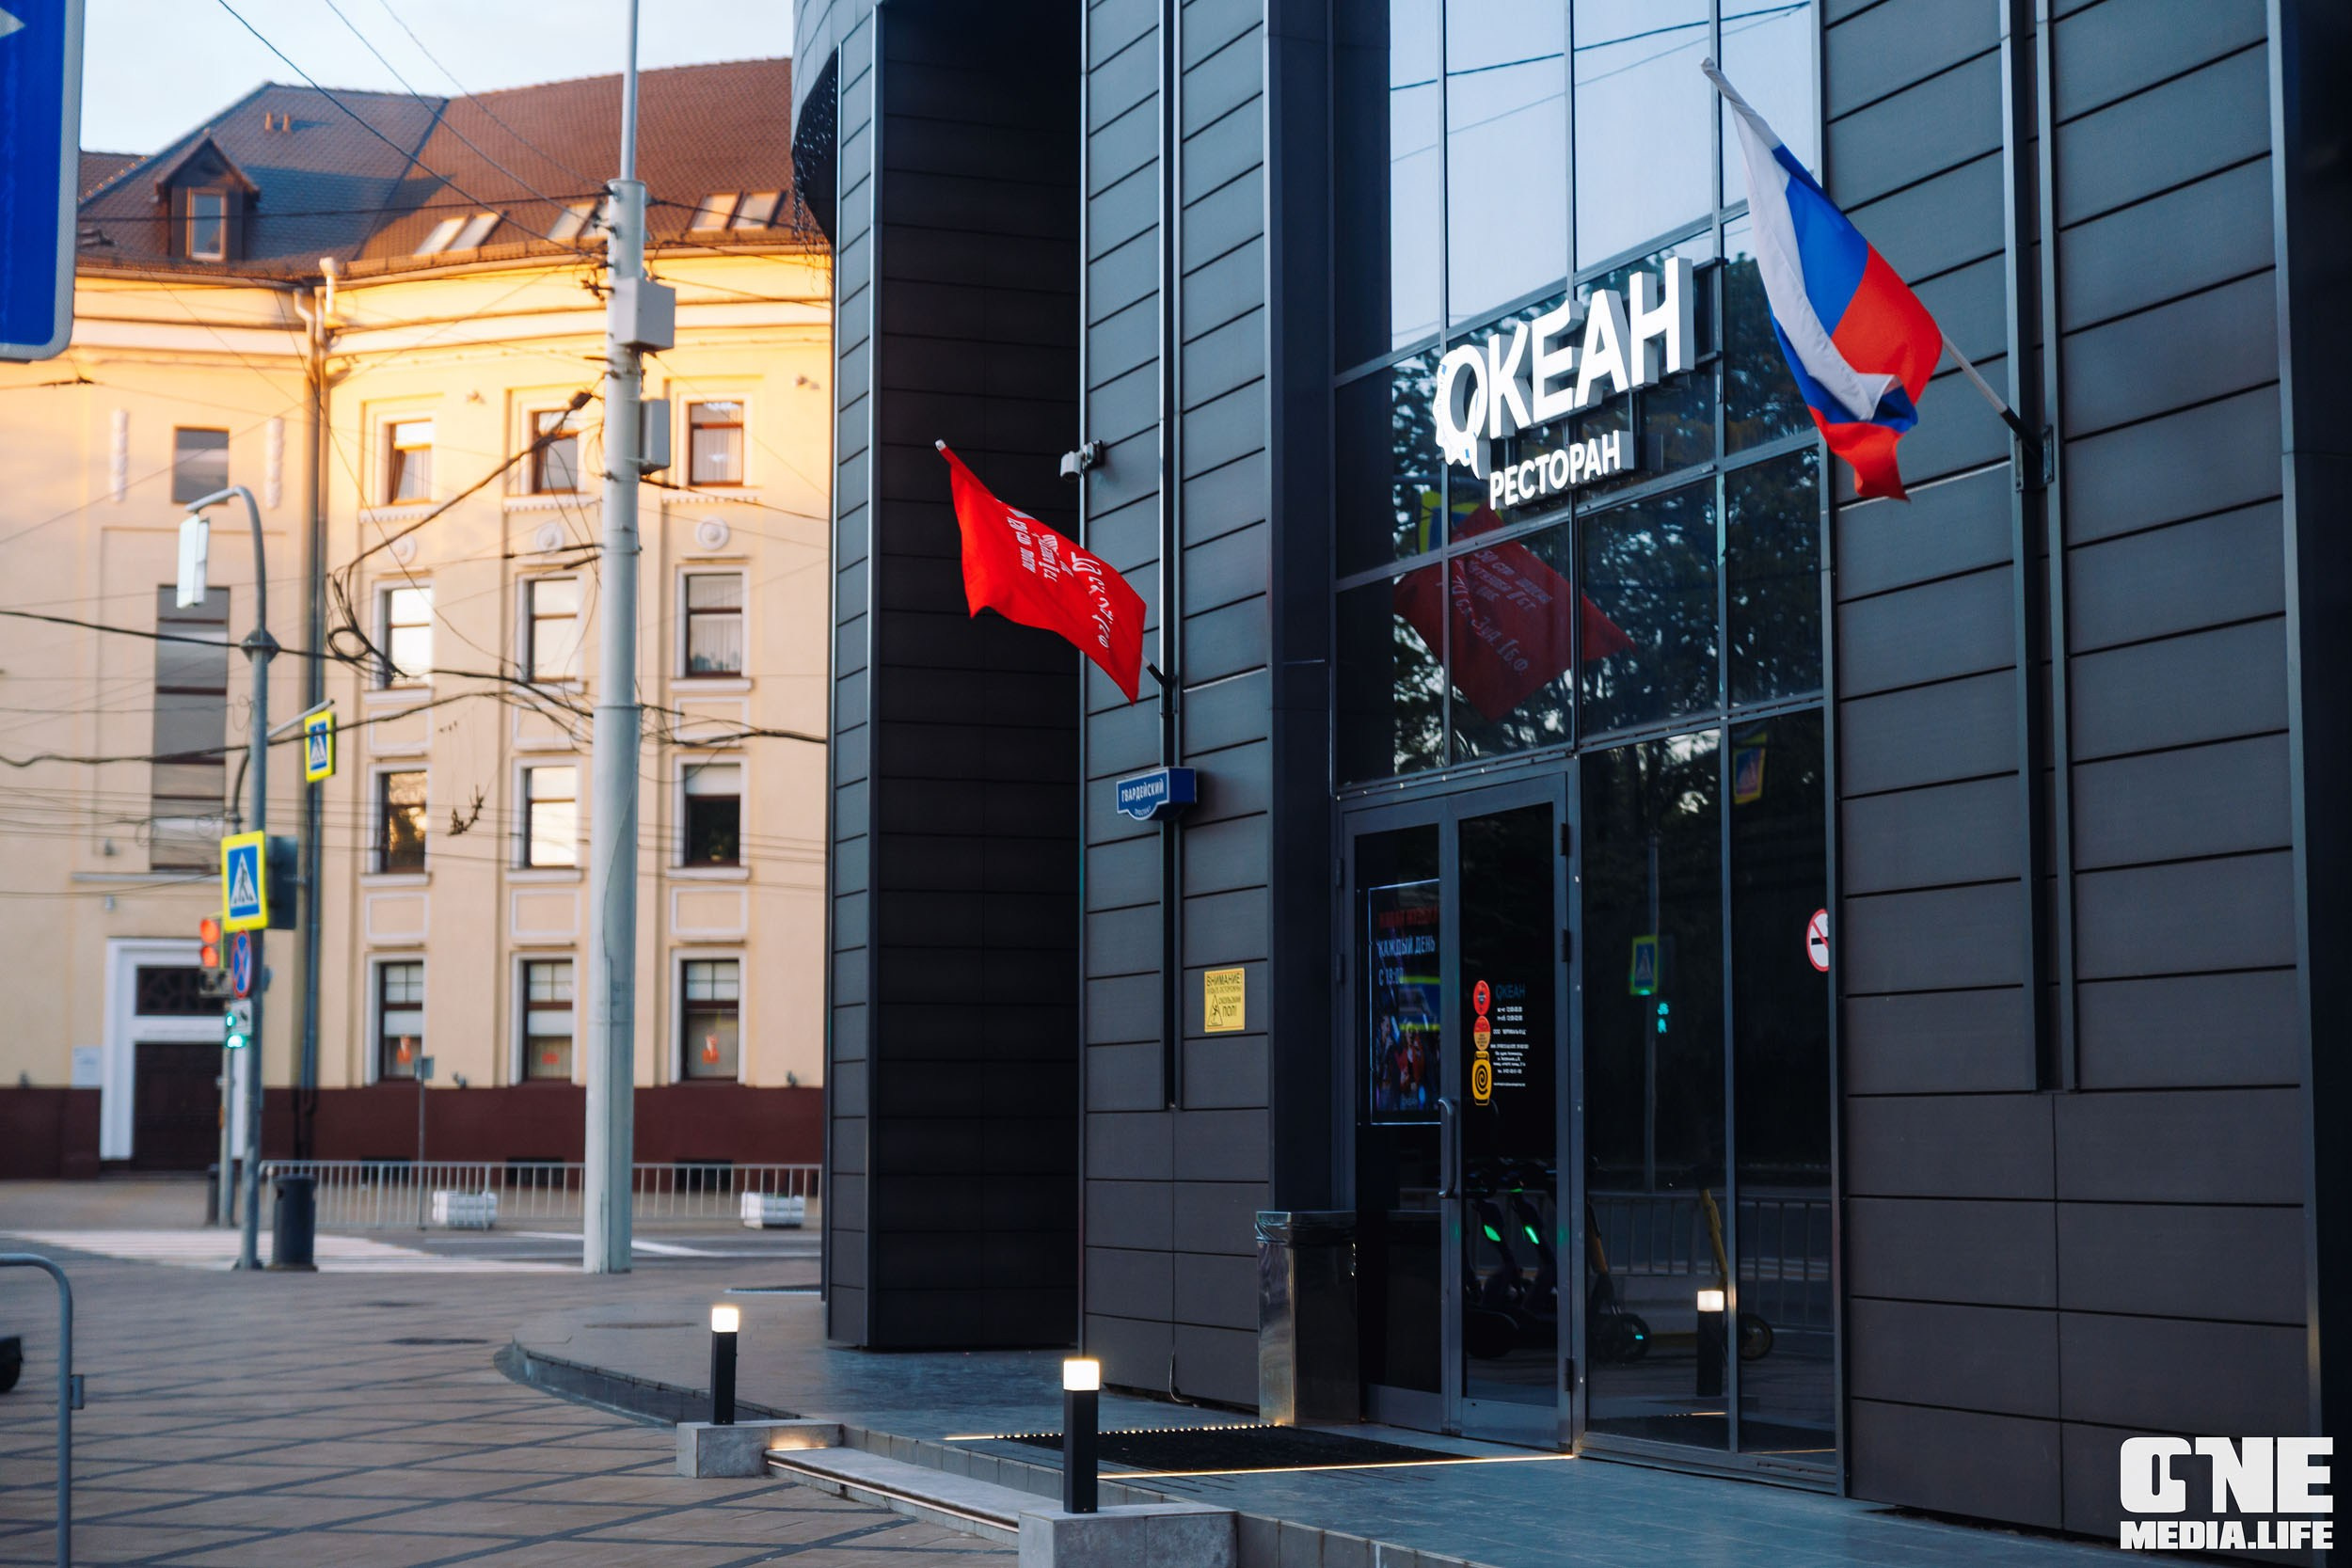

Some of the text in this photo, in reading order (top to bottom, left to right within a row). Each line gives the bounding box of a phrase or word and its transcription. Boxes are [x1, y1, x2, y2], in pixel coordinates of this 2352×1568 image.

[1433, 257, 1691, 480] ОКЕАН
[1490, 430, 1625, 511] РЕСТОРАН
[1121, 778, 1165, 803] ГВАРДЕЙСКИЙ
[1377, 935, 1436, 958] КАЖДЫЙ ДЕНЬ
